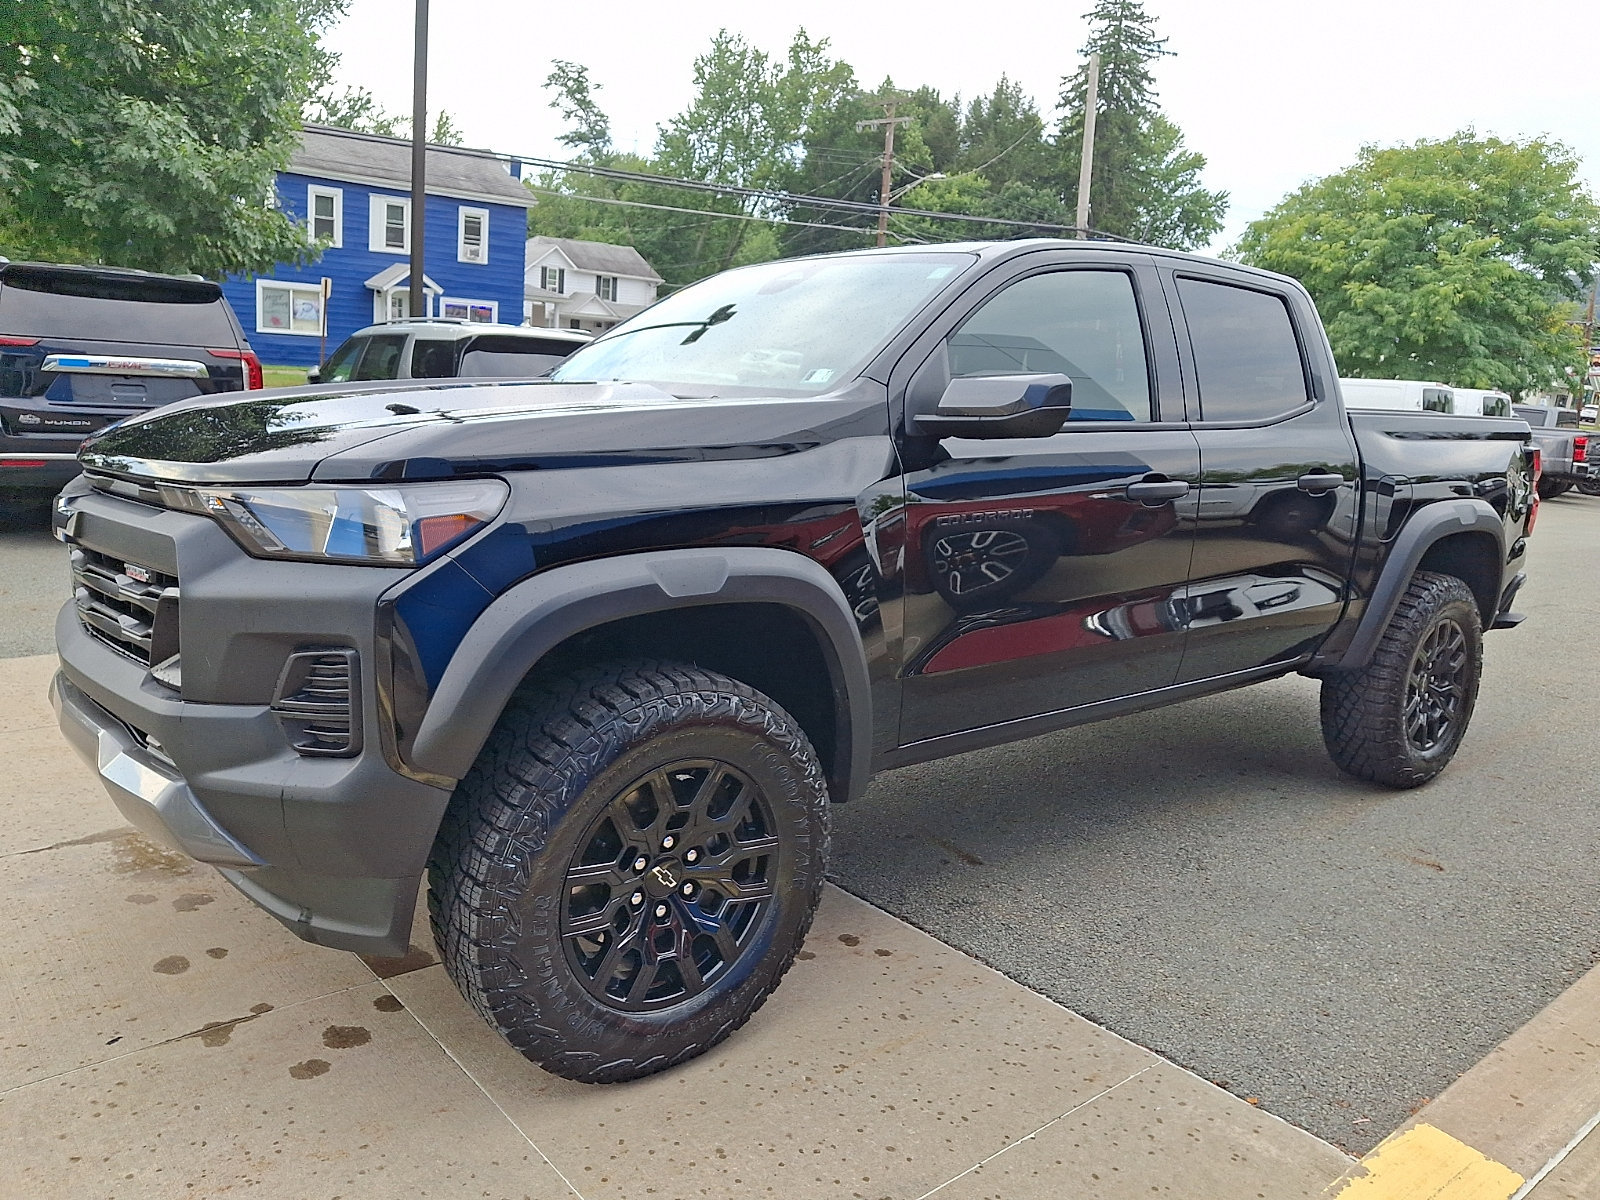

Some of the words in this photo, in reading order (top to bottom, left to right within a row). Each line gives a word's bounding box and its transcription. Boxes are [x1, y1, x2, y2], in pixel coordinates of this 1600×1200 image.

[107, 360, 151, 371] GMC
[936, 508, 1034, 527] COLORADO
[750, 742, 811, 890] GOODYEAR
